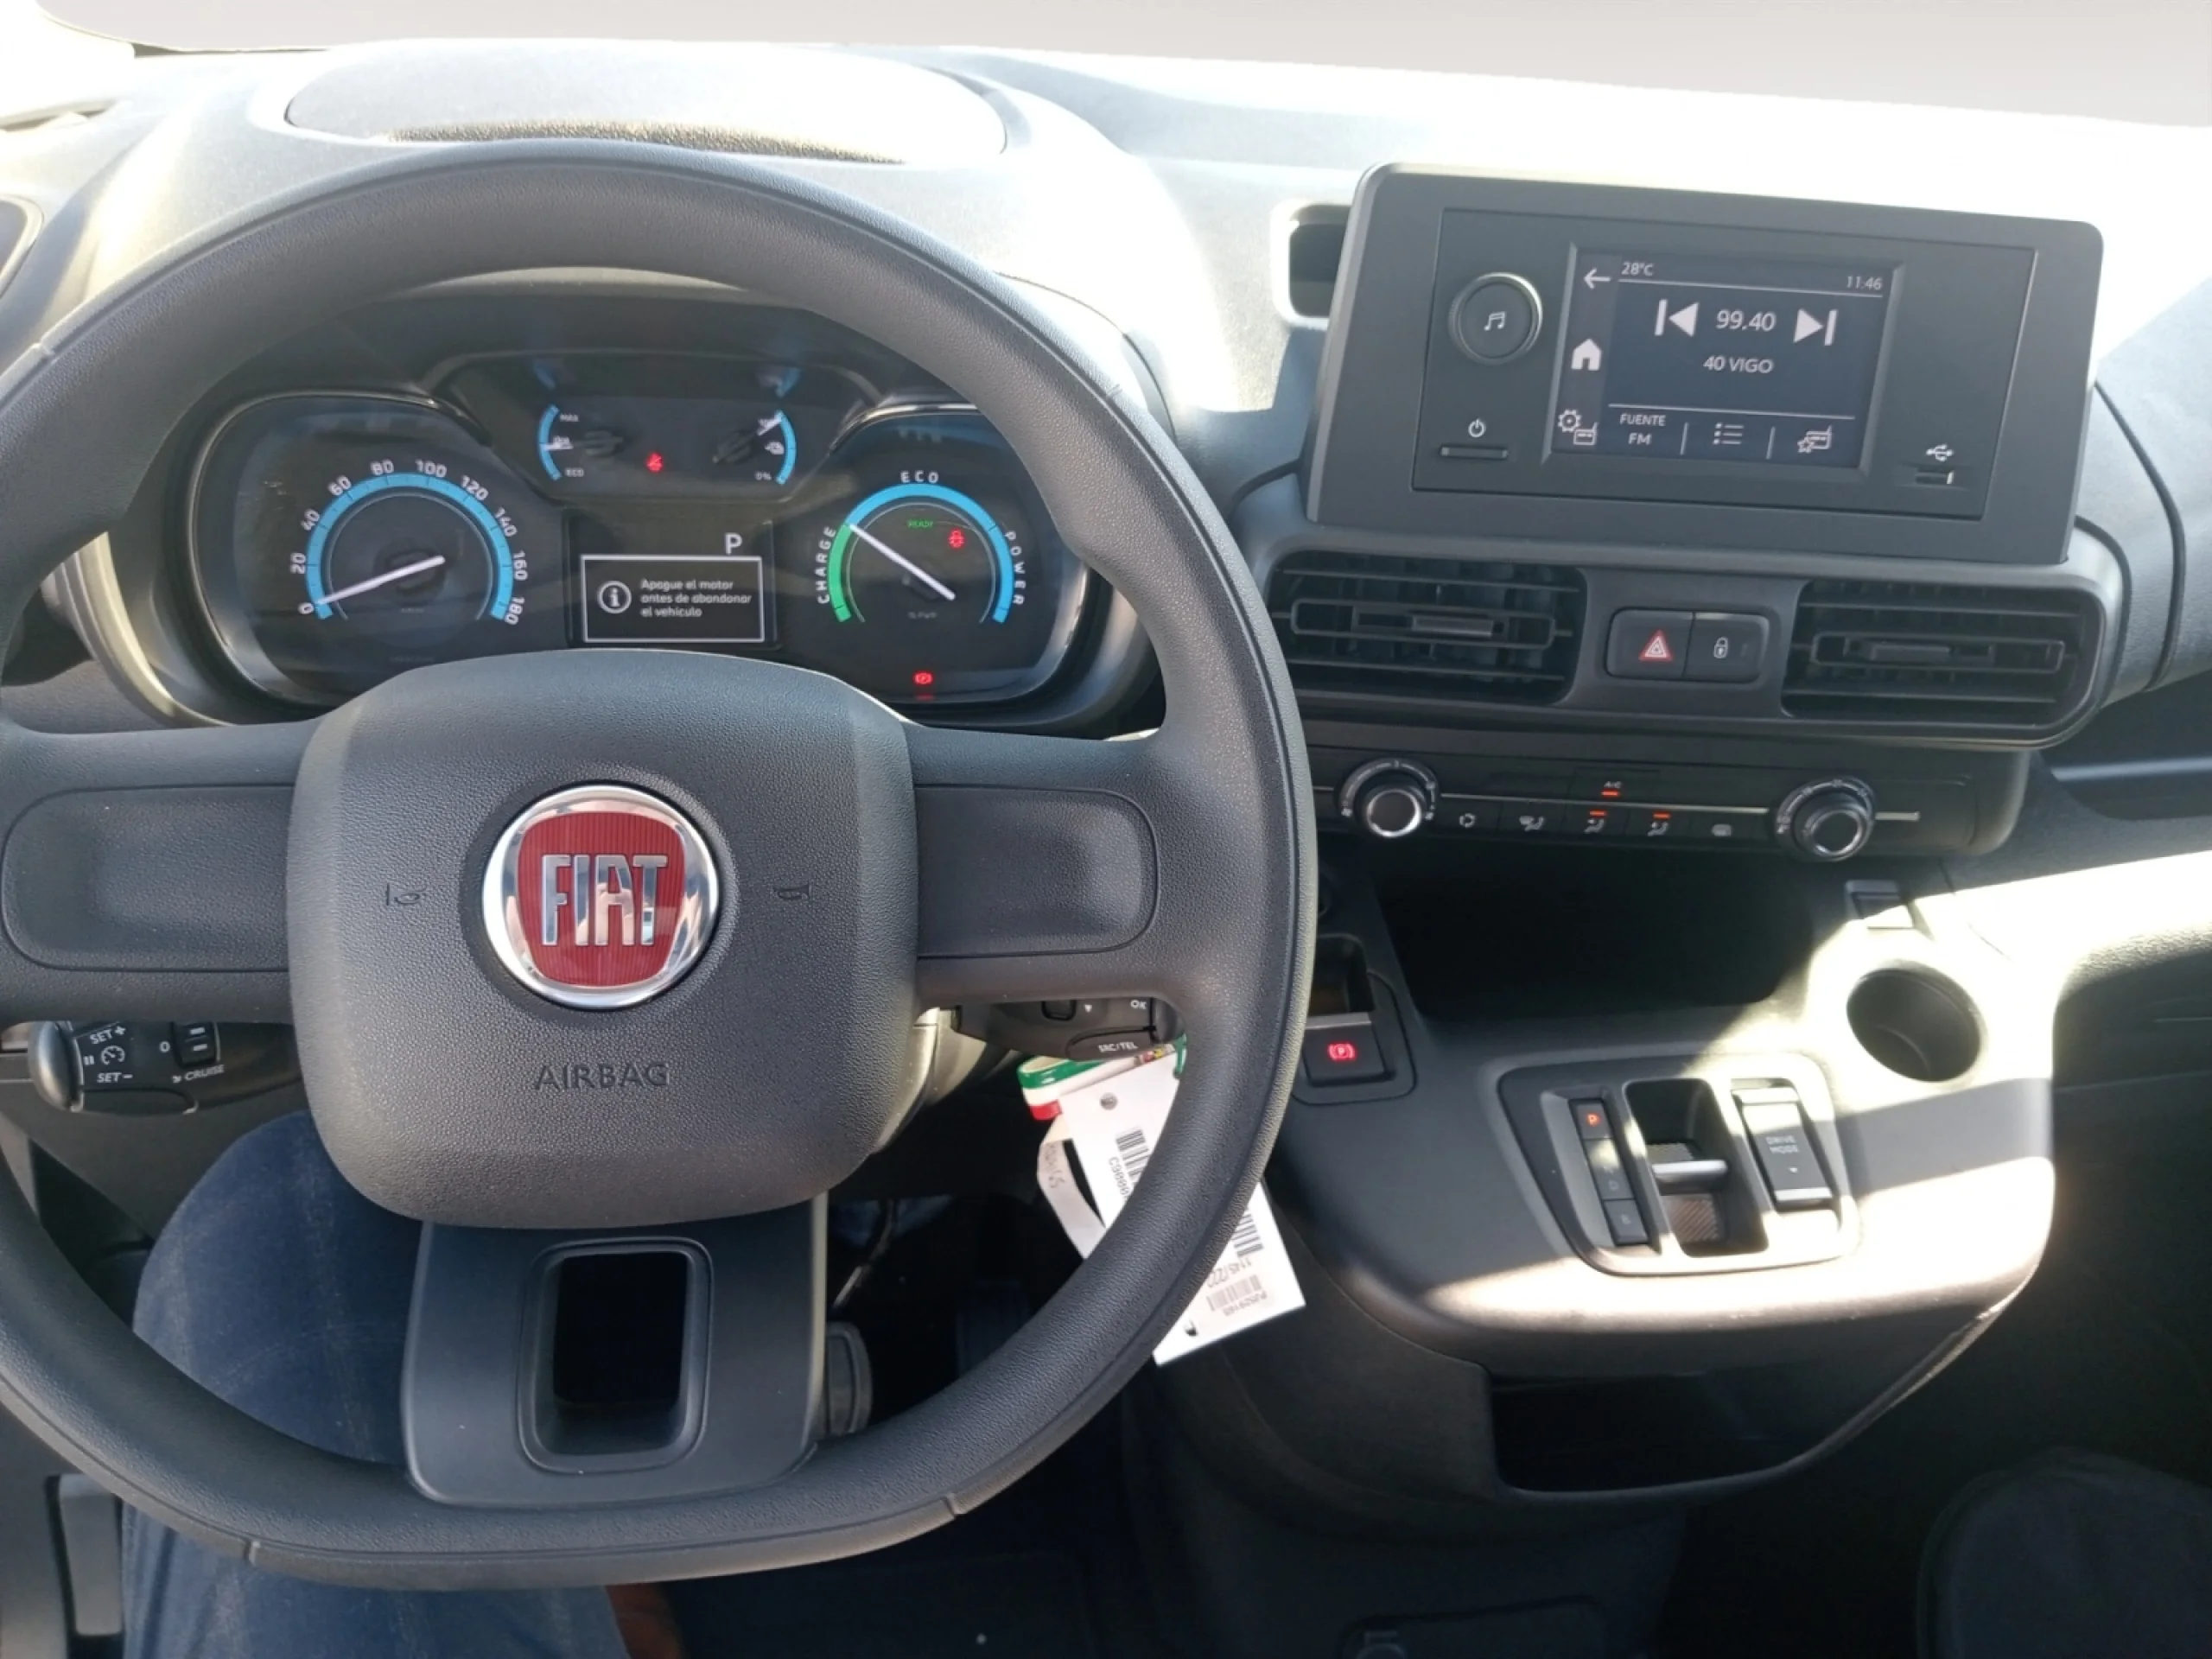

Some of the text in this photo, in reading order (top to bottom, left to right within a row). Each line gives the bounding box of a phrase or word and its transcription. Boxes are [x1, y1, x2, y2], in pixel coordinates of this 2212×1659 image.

[1621, 262, 1654, 276] 28°C
[1847, 276, 1883, 290] 11:46
[1715, 309, 1777, 333] 99.40
[1703, 355, 1774, 373] 40 VIGO
[1620, 413, 1666, 427] FUENTE
[1629, 433, 1651, 445] FM
[370, 459, 394, 475] 80
[415, 459, 448, 478] 100
[327, 474, 352, 496] 60
[899, 470, 939, 483] ECO
[460, 474, 489, 501] 120
[302, 508, 321, 531] 40
[494, 506, 517, 537] 140
[725, 533, 742, 554] P
[290, 552, 306, 575] 20
[512, 550, 528, 581] 160
[814, 526, 836, 605] CHARGE
[1005, 531, 1027, 605] POWER
[640, 579, 733, 592] Apague el motor
[640, 593, 752, 604] antes de abandonar
[297, 602, 315, 614] 0
[504, 596, 524, 626] 180
[640, 606, 653, 617] el
[540, 854, 668, 946] FIAT
[1130, 999, 1147, 1009] OK
[184, 1064, 225, 1081] CRUISE
[535, 1063, 670, 1090] AIRBAG
[1587, 1114, 1598, 1125] P
[1765, 1135, 1796, 1145] DRIVE
